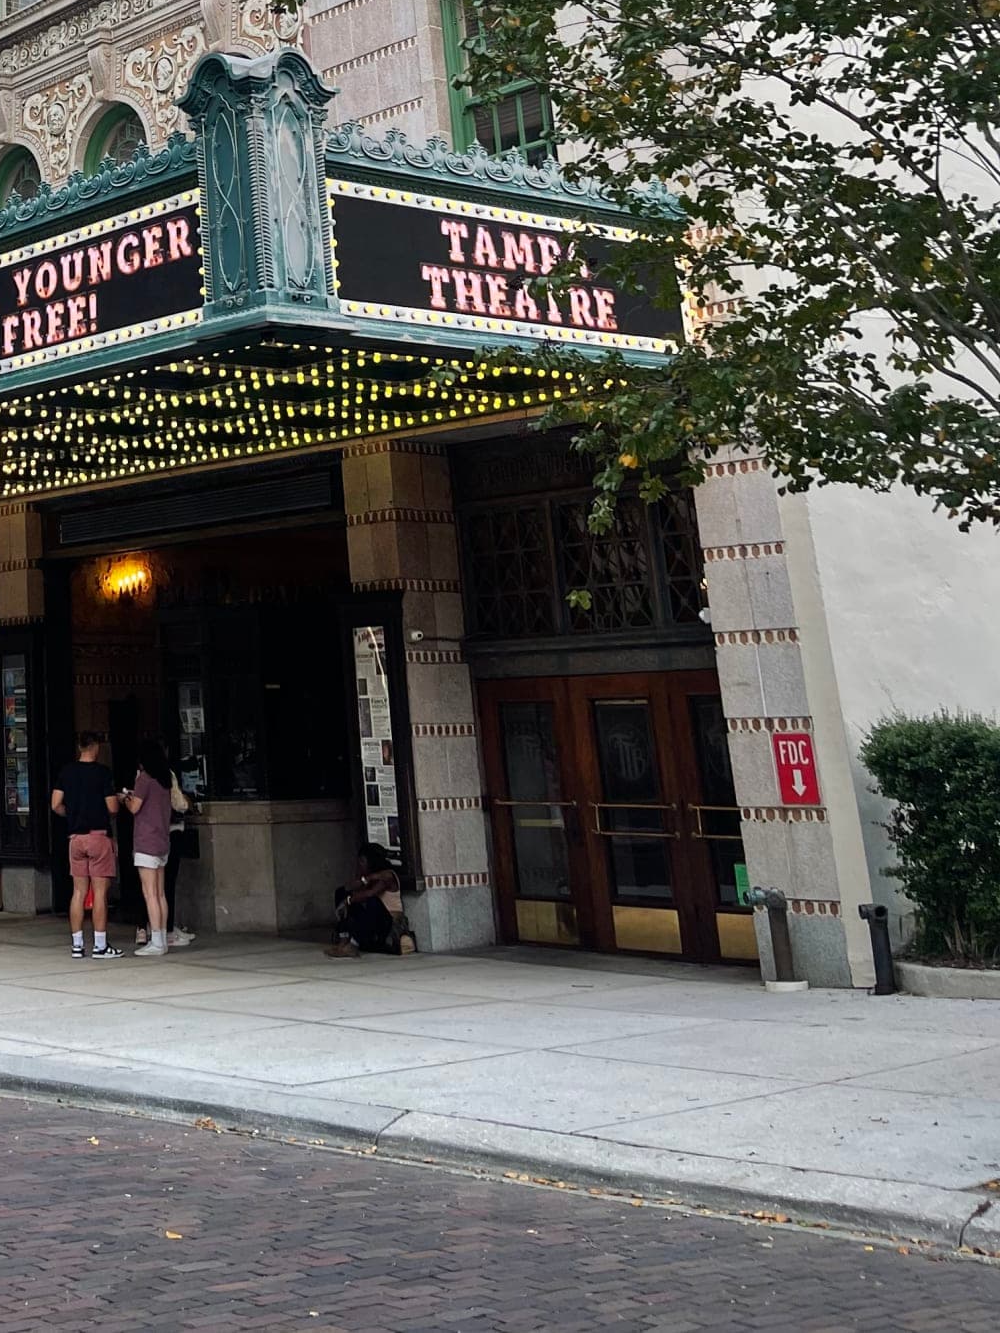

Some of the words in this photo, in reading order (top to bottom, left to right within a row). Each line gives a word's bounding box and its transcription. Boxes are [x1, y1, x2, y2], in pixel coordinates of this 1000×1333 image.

[12, 217, 193, 307] YOUNGER
[1, 292, 98, 357] FREE!
[778, 740, 810, 765] FDC
